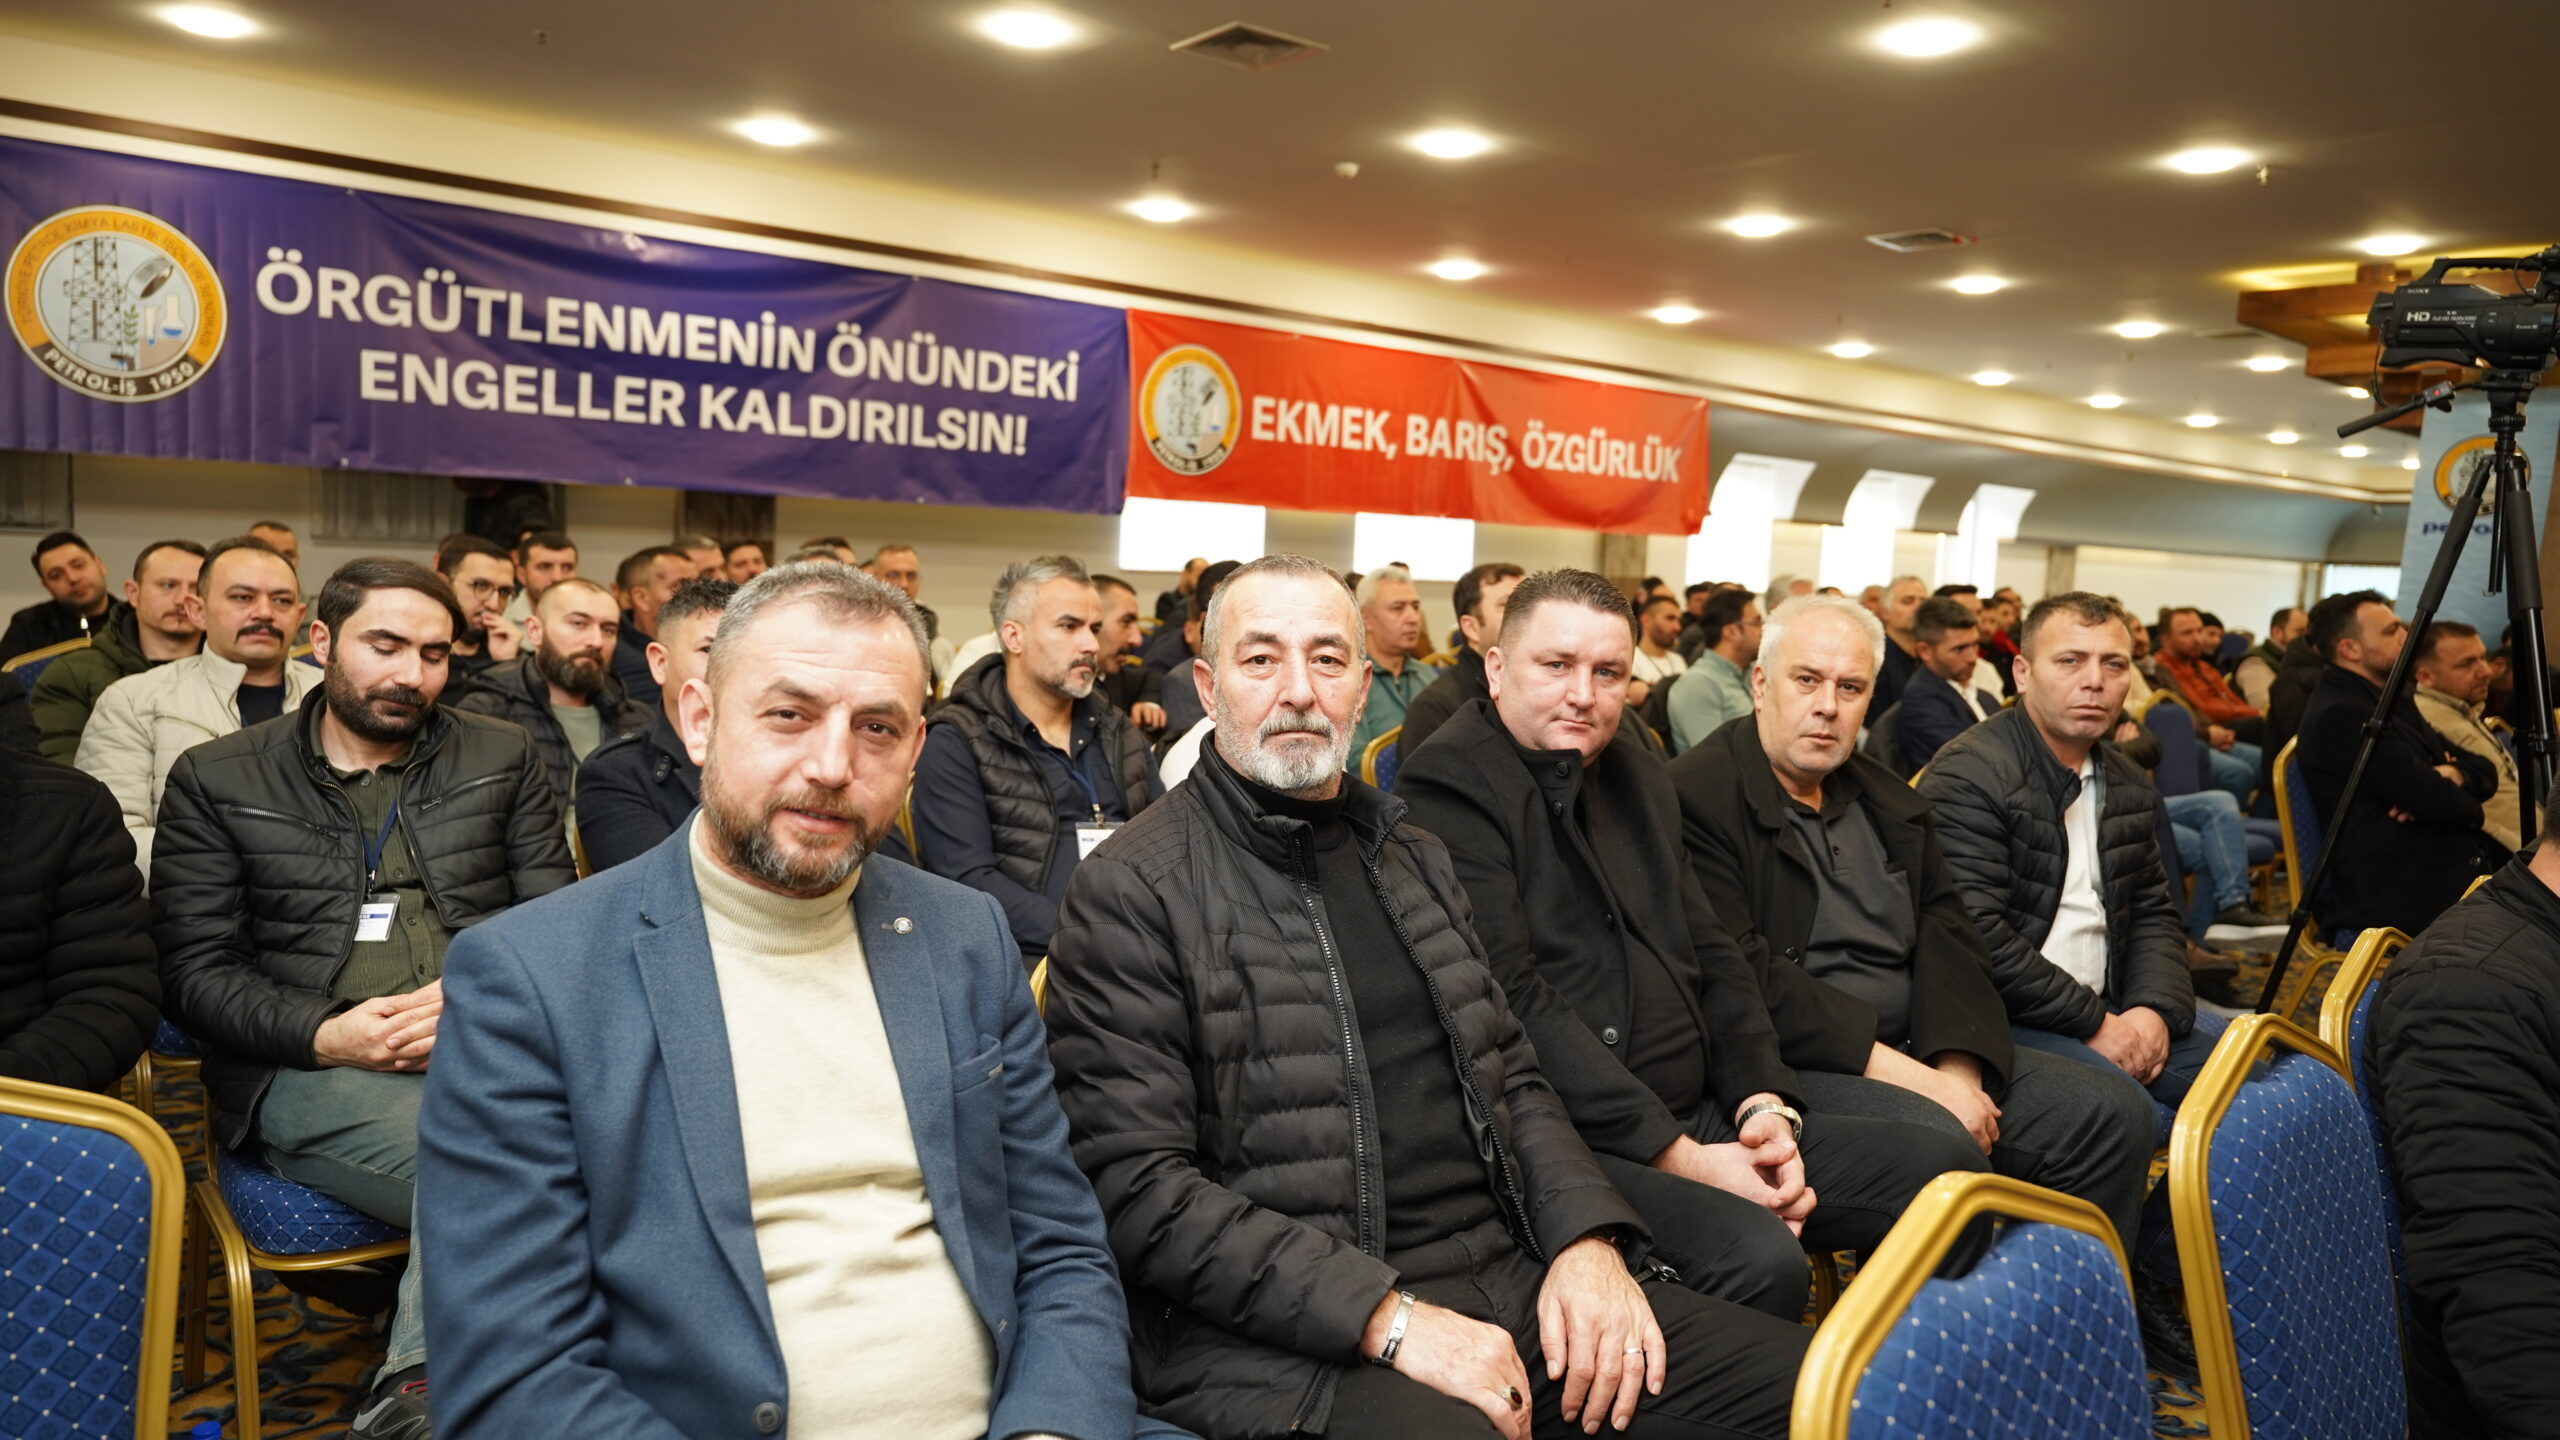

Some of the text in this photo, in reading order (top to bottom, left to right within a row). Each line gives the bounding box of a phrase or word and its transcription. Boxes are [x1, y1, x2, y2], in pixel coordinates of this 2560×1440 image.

[255, 246, 1081, 401] ÖRGÜTLENMENİN ÖNÜNDEKİ
[2406, 311, 2431, 322] HD
[149, 361, 194, 392] 1950
[360, 348, 1028, 455] ENGELLER KALDIRILSIN!
[1251, 396, 1397, 460] EKMEK,
[1405, 413, 1514, 475] BARIŞ,
[1521, 419, 1683, 482] ÖZGÜRLÜK
